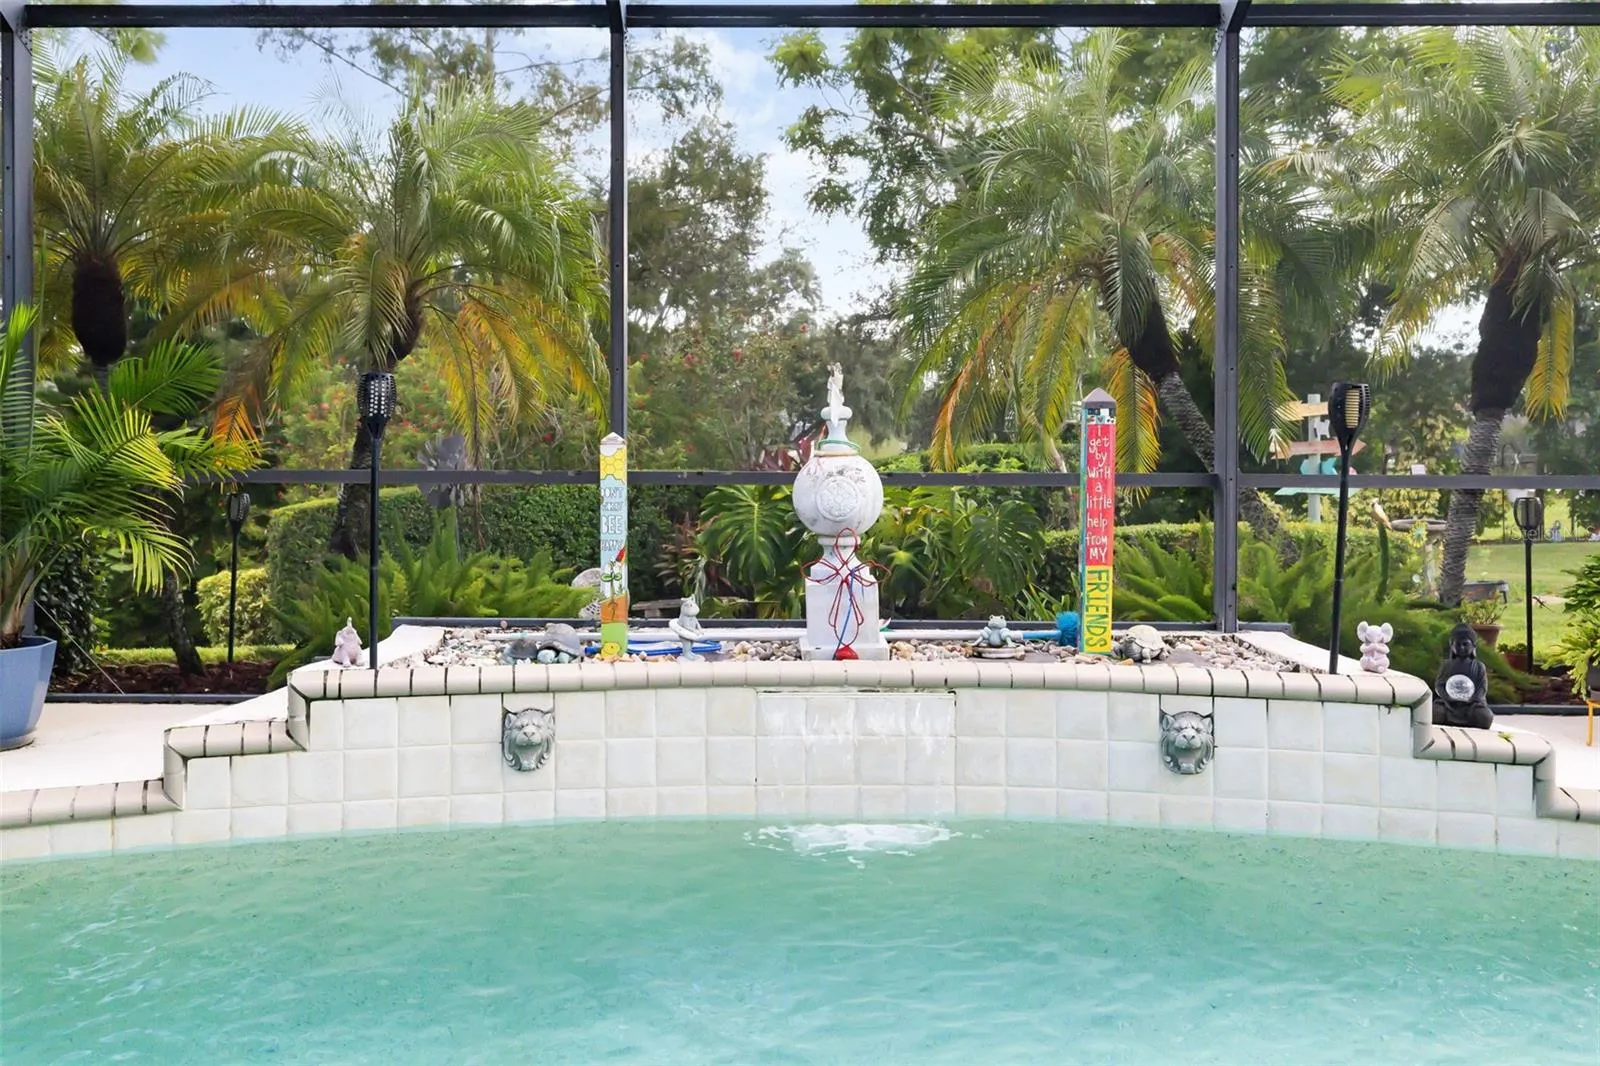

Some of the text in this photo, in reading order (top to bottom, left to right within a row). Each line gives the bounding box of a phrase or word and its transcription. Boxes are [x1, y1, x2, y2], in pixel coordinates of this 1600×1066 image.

[1089, 437, 1109, 453] get
[1095, 451, 1107, 467] by
[1095, 482, 1103, 493] a
[1086, 495, 1112, 509] little
[601, 515, 623, 534] BEE
[1086, 512, 1107, 531] help
[1089, 547, 1107, 563] MY
[1085, 569, 1110, 648] FRIENDS
